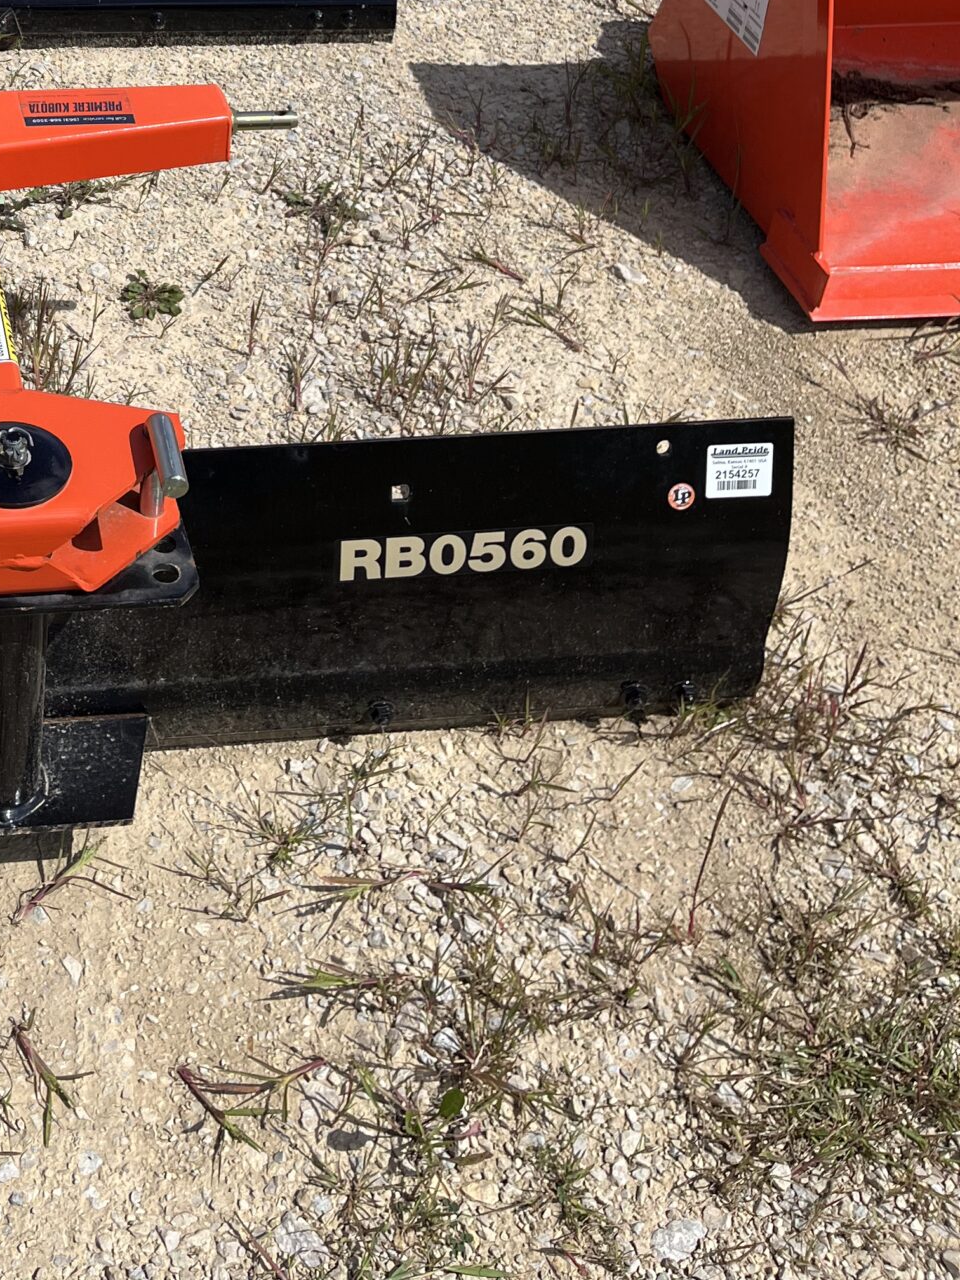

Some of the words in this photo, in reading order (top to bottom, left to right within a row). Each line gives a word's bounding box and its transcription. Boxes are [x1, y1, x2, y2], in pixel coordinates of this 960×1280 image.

[28, 102, 70, 114] KUBOTA
[73, 101, 123, 112] PREMIERE
[713, 447, 738, 455] Land
[742, 446, 769, 455] Pride
[715, 468, 760, 480] 2154257
[339, 525, 587, 581] RB0560
